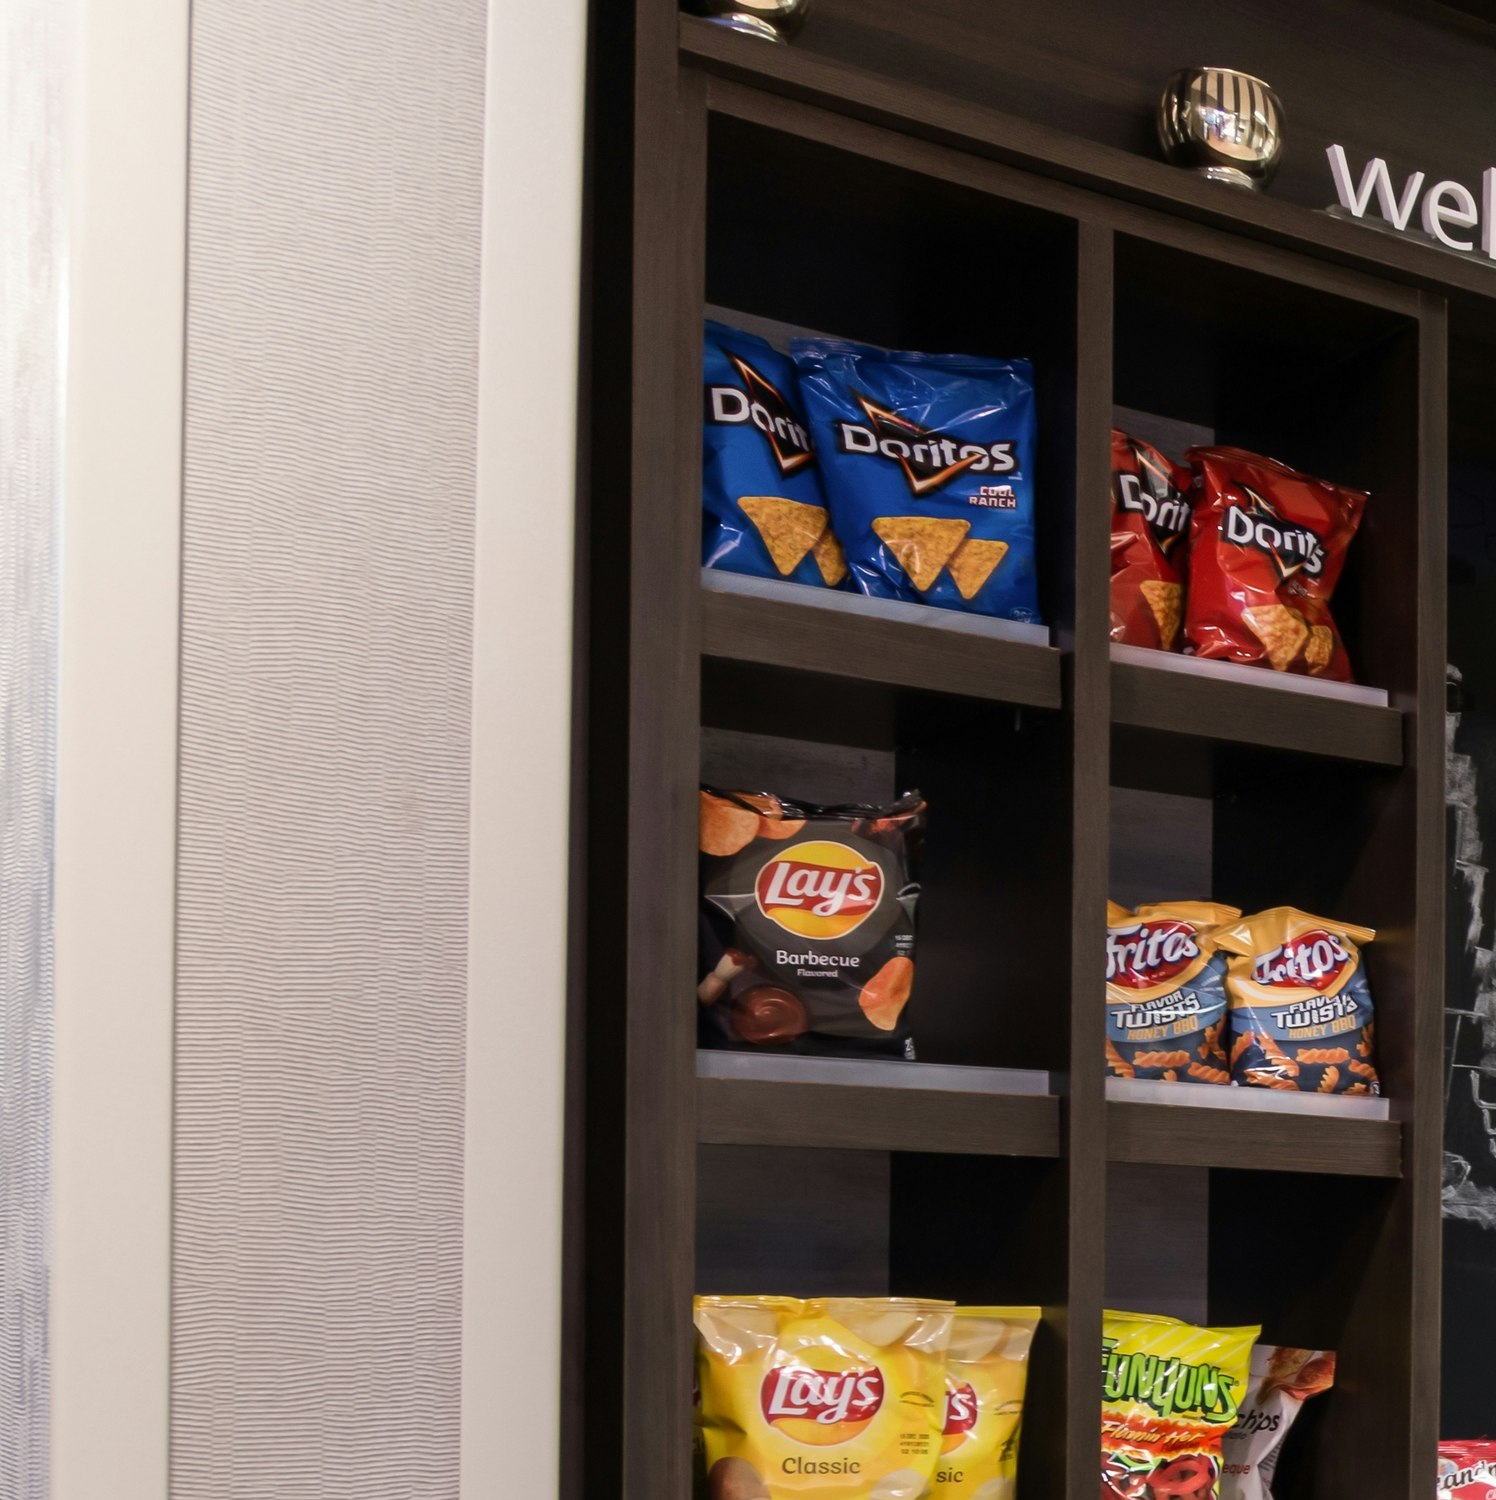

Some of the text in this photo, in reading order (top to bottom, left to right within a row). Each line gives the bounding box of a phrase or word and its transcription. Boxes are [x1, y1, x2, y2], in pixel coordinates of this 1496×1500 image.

[711, 387, 812, 452] Dorit
[840, 423, 1015, 472] Doritos
[969, 497, 1016, 508] RANCH
[979, 485, 1015, 497] COOL
[1119, 474, 1192, 532] Dorit
[1227, 505, 1325, 574] Dorits
[764, 862, 877, 917] Lay's
[776, 950, 860, 968] Barbecue
[797, 968, 838, 979] Flavored
[1111, 992, 1200, 1029] TWISTS
[1131, 991, 1184, 1012] FLAVOR
[1127, 1017, 1199, 1041] HONEY BBQ
[1288, 1024, 1326, 1039] HONEY
[768, 1366, 880, 1425] Lay's
[781, 1456, 861, 1475] Classic
